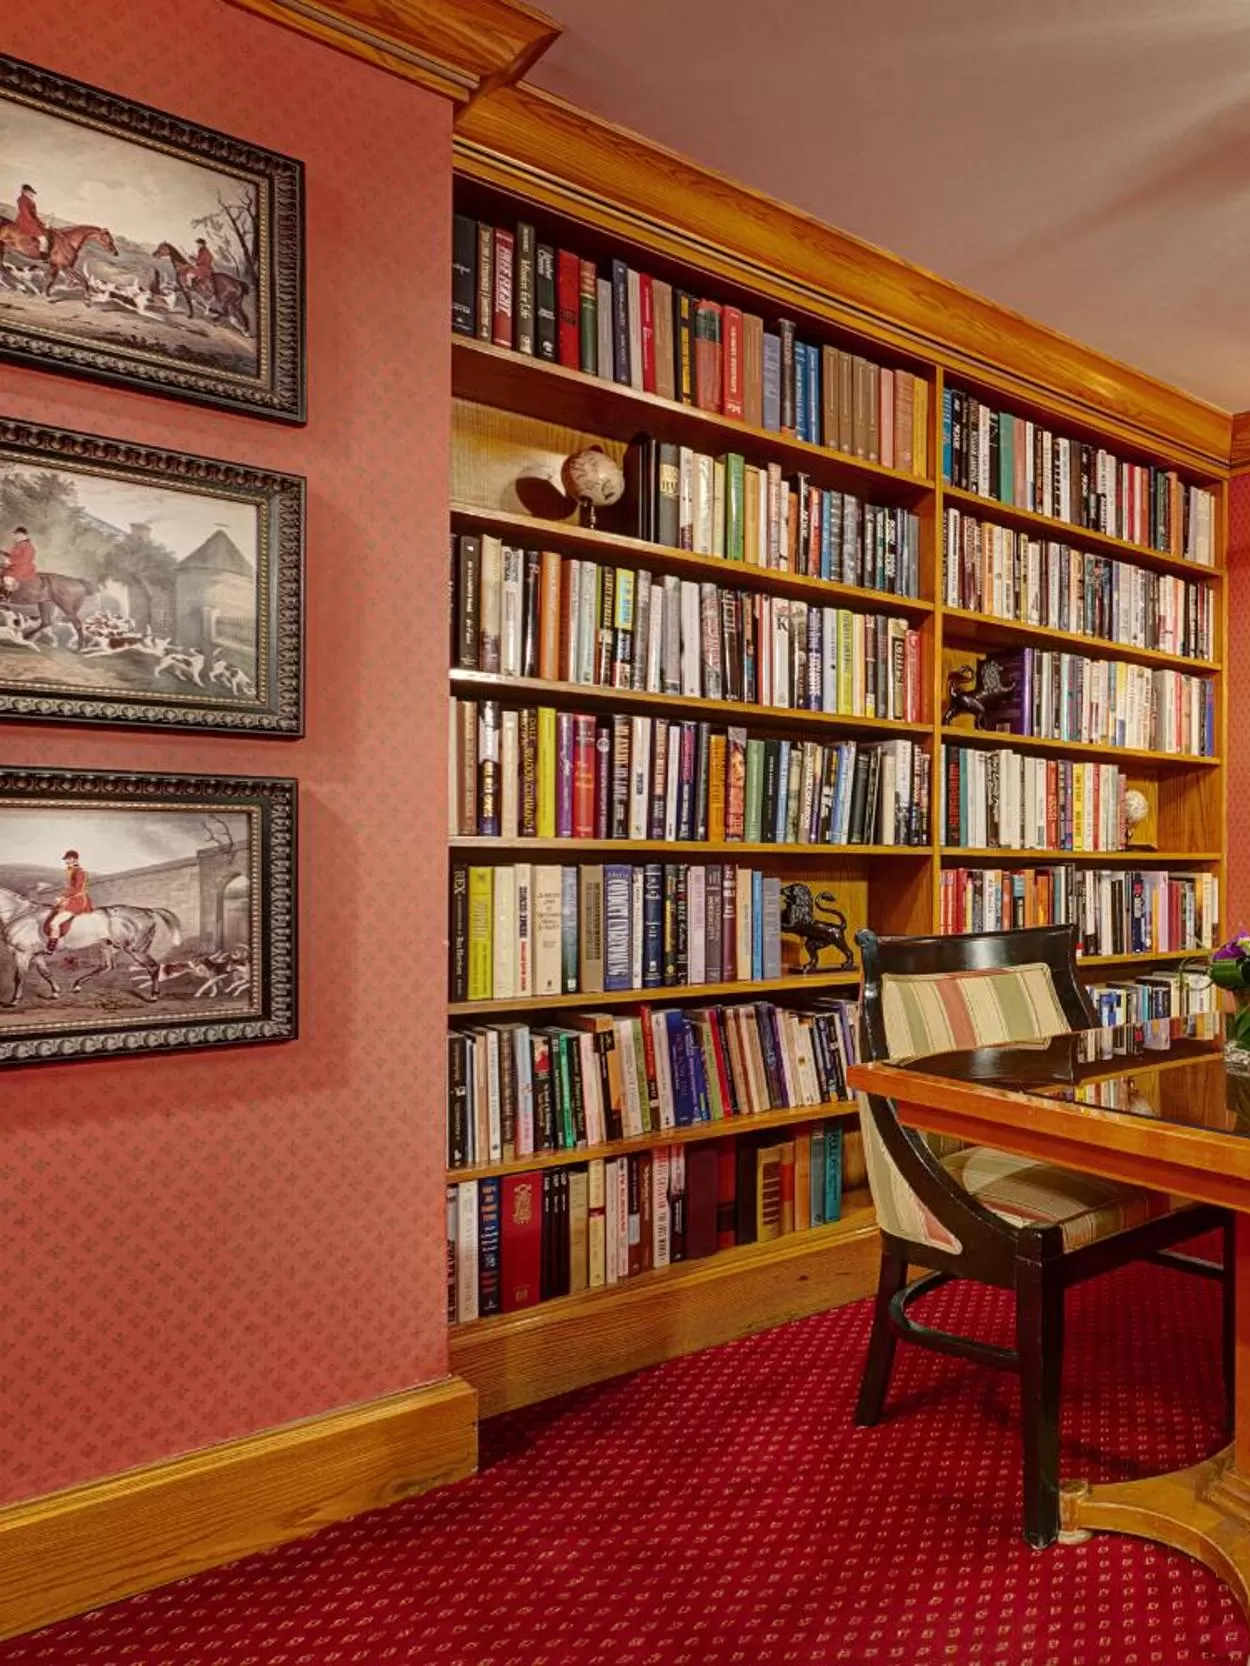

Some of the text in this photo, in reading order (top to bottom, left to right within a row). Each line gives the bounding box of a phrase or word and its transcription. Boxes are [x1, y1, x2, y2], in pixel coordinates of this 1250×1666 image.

[523, 782, 534, 827] COMMAND
[454, 870, 465, 894] REX
[608, 880, 628, 917] CONDUCT
[608, 919, 628, 976] UNBECOMING
